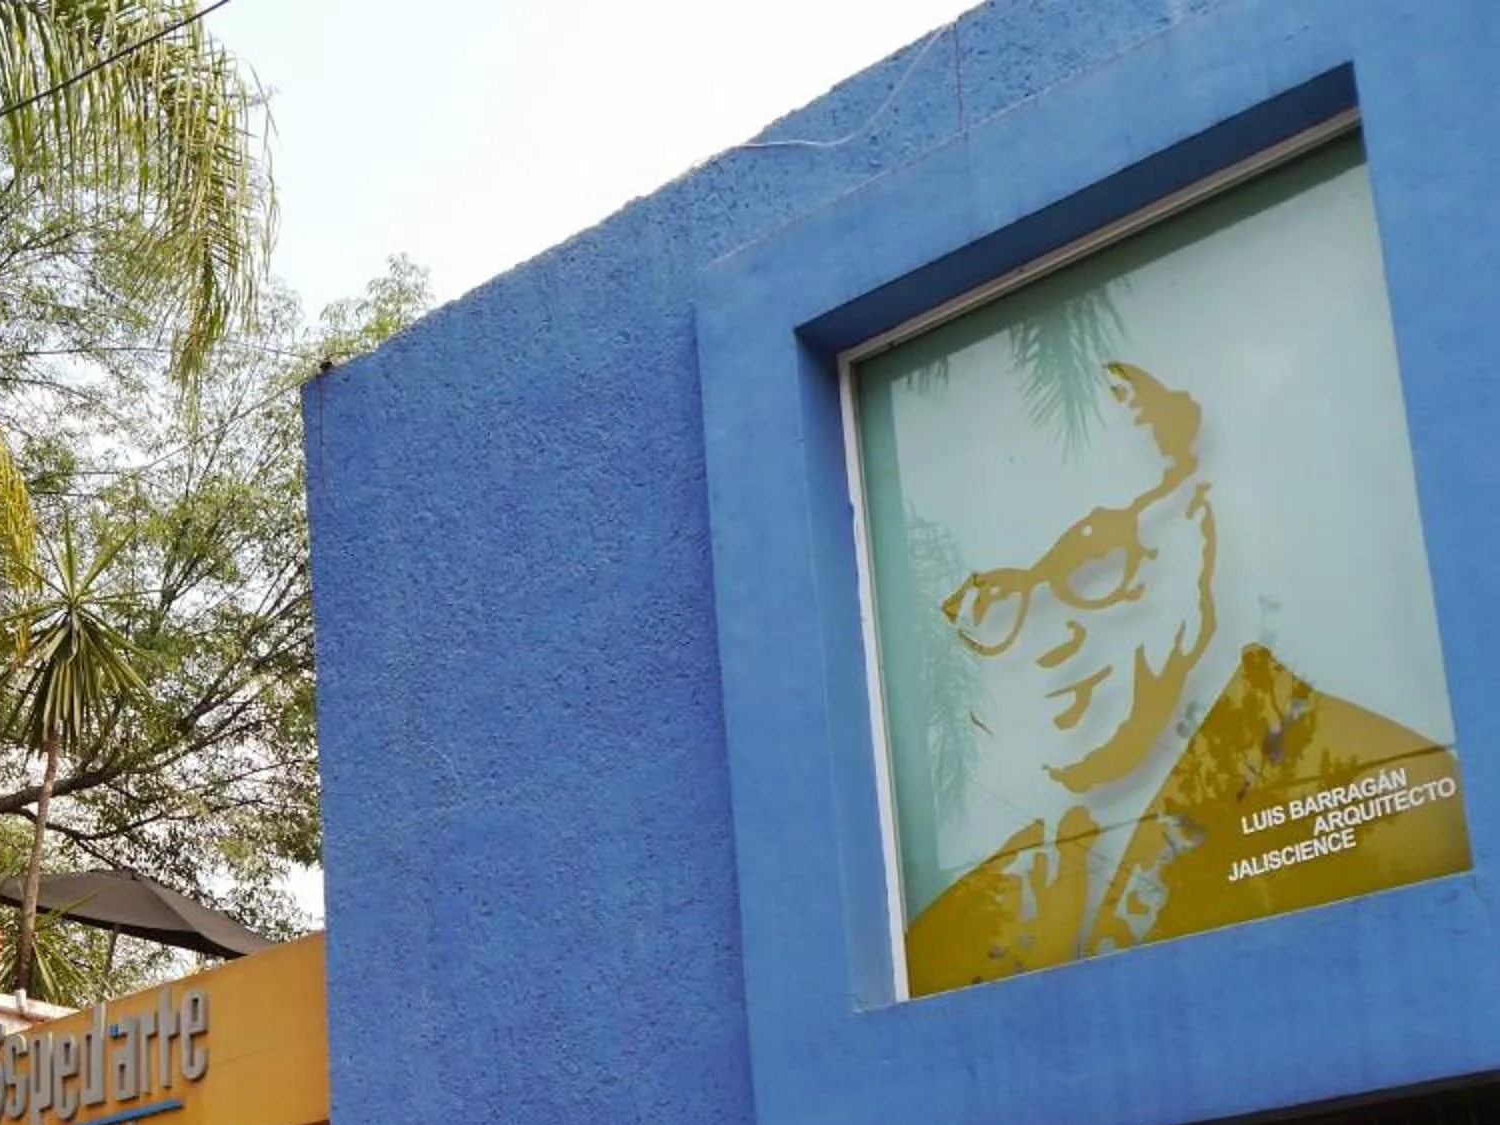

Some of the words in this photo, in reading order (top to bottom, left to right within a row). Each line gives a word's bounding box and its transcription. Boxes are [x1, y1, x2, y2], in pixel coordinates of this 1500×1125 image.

[1241, 805, 1286, 835] LUIS
[1289, 767, 1407, 820] BARRAGÁN
[1313, 776, 1456, 837] ARQUITECTO
[1228, 828, 1357, 882] JALISCIENCE
